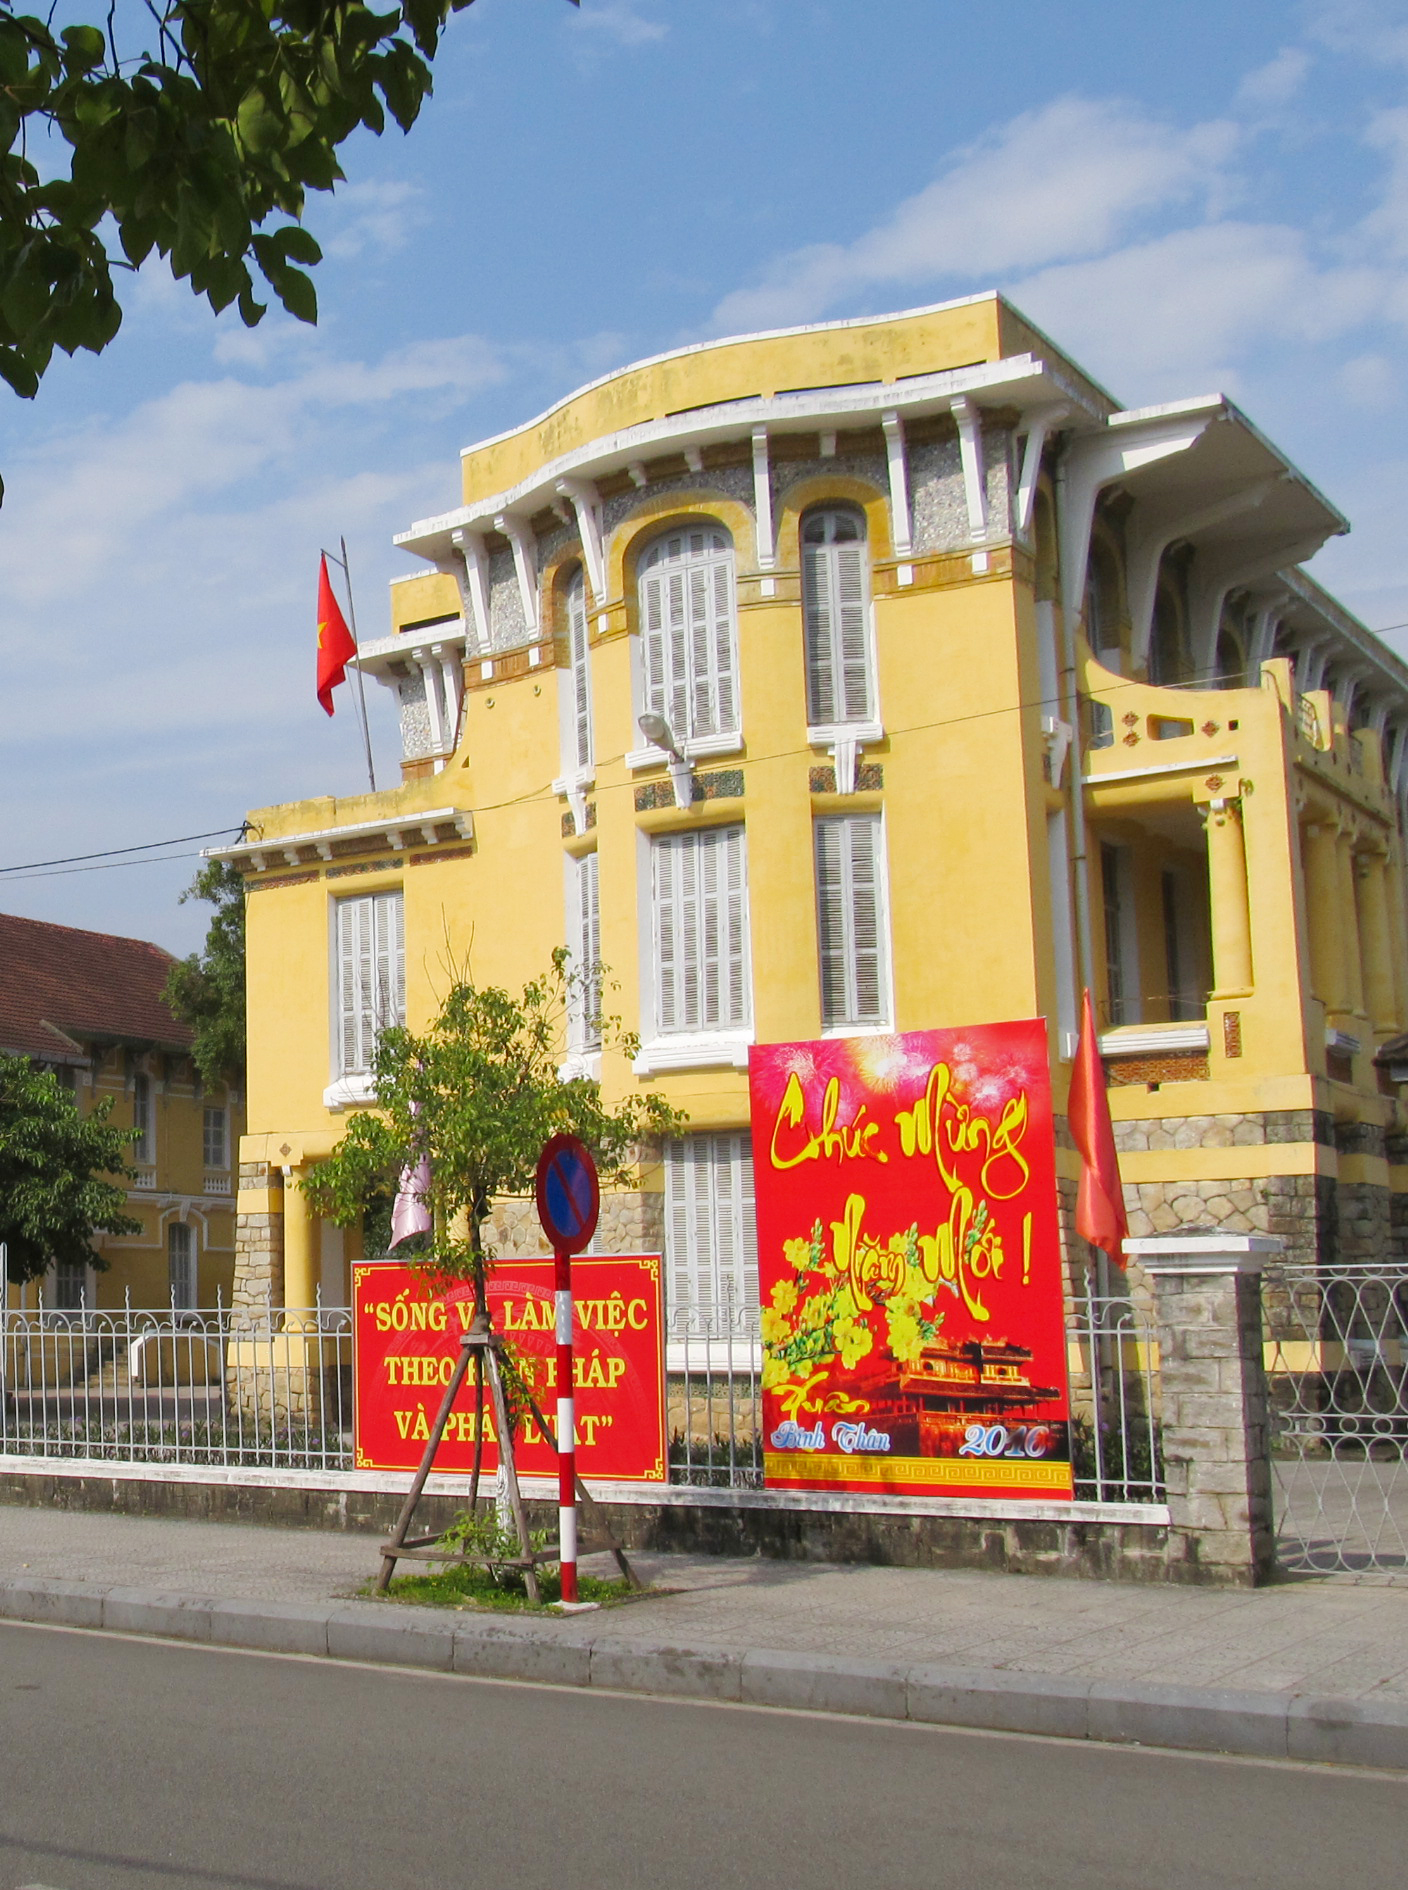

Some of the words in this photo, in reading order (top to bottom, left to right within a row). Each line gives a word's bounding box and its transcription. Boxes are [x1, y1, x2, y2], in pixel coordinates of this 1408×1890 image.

[770, 1071, 888, 1169] Chúc
[894, 1062, 1030, 1199] Mừng
[829, 1193, 906, 1311] Năm
[456, 1293, 494, 1331] V
[574, 1290, 649, 1338] VIỆC
[384, 1356, 456, 1386] THEO
[393, 1402, 431, 1440] VÀ
[440, 1403, 500, 1443] PHÁ
[771, 1420, 825, 1449] Bính
[832, 1421, 891, 1453] Thân
[959, 1424, 1049, 1456] 2016
